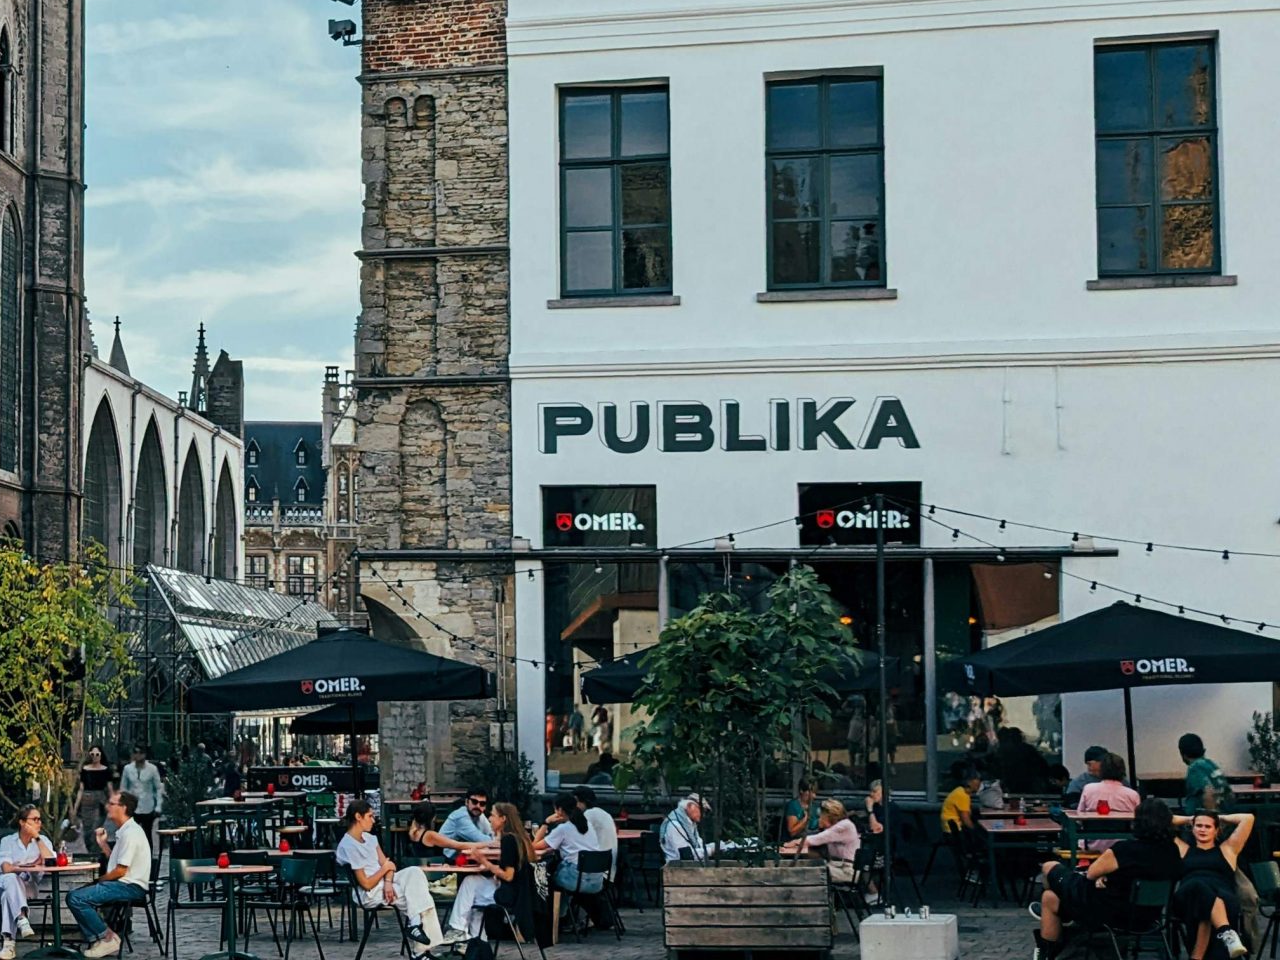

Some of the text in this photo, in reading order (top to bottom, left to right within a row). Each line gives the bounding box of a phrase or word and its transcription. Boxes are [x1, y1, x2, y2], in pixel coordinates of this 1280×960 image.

[537, 396, 921, 454] PUBLIKA
[574, 512, 645, 531] OMER.
[1136, 657, 1196, 674] OMER.
[314, 677, 366, 693] OMER.
[291, 774, 333, 786] OMER.
